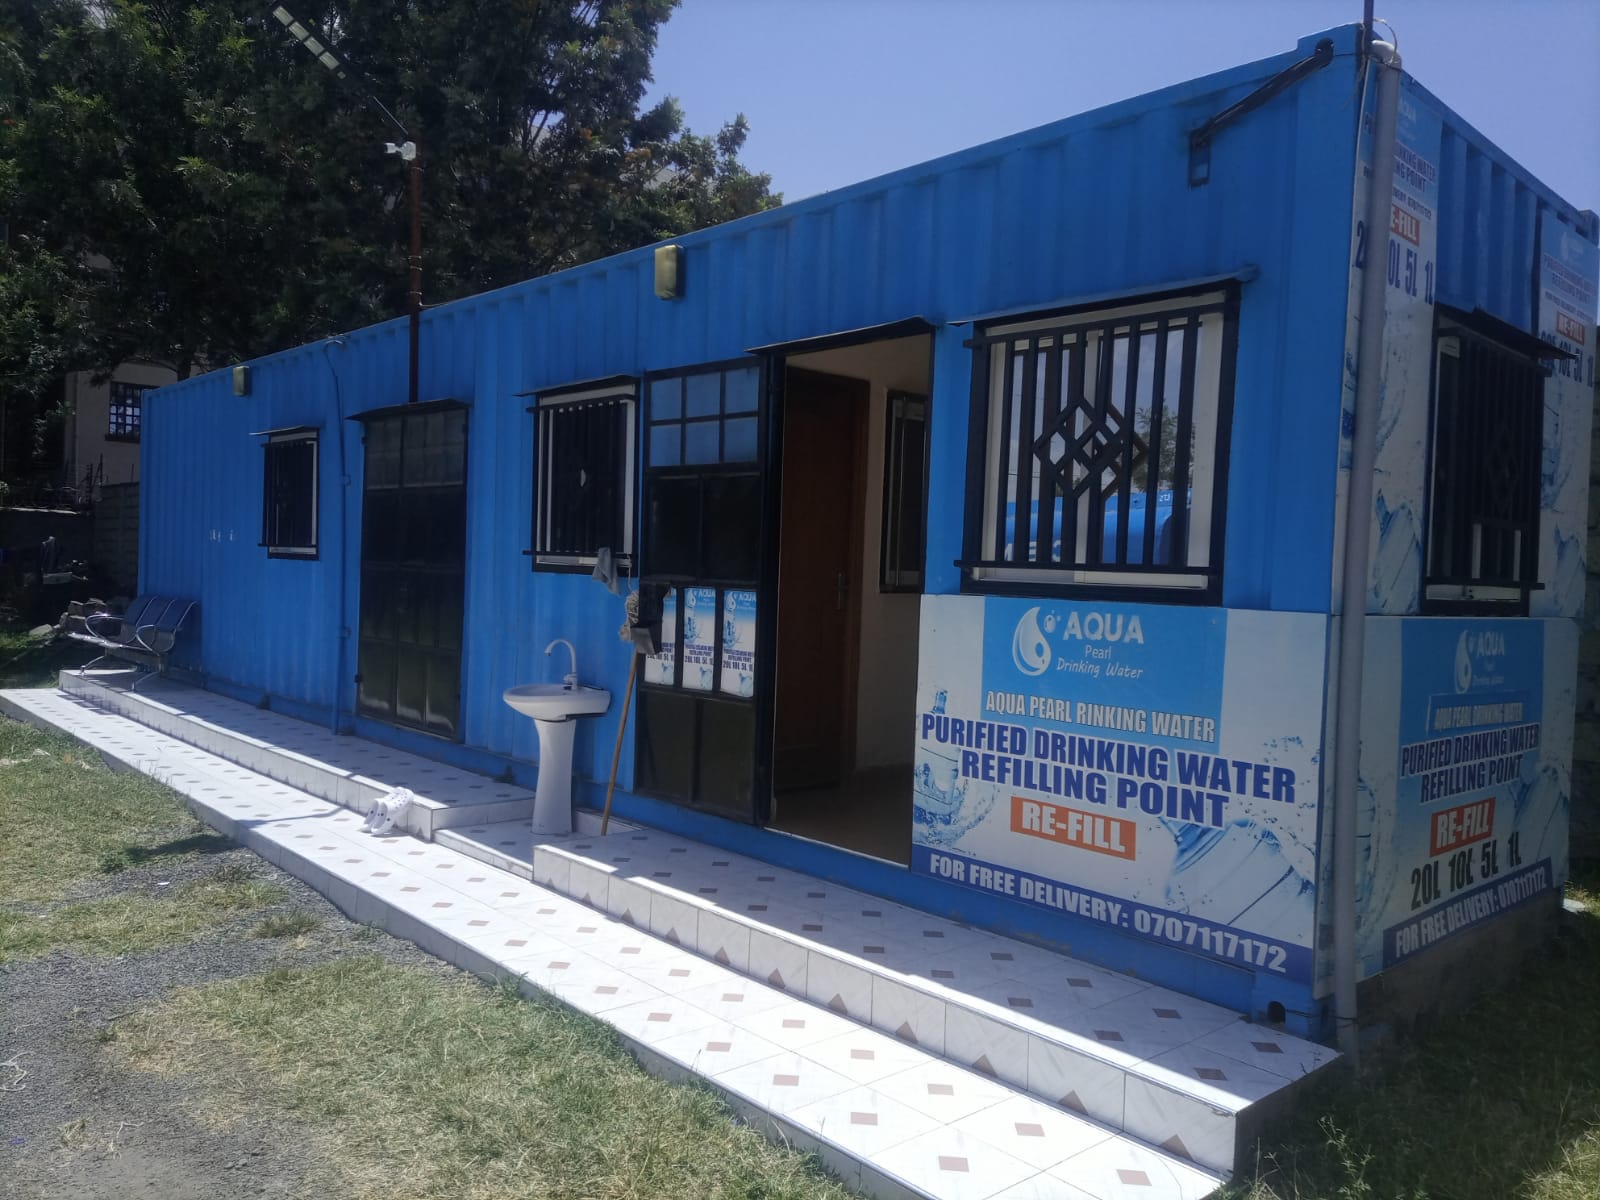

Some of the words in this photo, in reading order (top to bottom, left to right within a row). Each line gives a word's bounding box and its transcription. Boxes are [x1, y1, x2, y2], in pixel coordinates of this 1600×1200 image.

[1392, 206, 1416, 241] E-FILL
[1062, 611, 1145, 645] AQUA
[1085, 644, 1112, 660] Pearl
[1477, 631, 1505, 657] AQUA
[1056, 658, 1101, 678] Drinking
[1105, 662, 1144, 680] Water
[986, 690, 1026, 716] AQUA
[1029, 695, 1073, 723] PEARL
[1076, 701, 1148, 734] RINKING
[1151, 711, 1216, 743] WATER
[922, 713, 1028, 756] PURIFIED
[1034, 729, 1169, 782] DRINKING
[1176, 752, 1297, 804] WATER
[1402, 738, 1452, 777] PURIFIED
[1454, 729, 1508, 764] DRINKING
[1508, 724, 1540, 753] WATER
[961, 750, 1108, 806] REFILLING
[1116, 777, 1230, 828] POINT
[1421, 761, 1485, 804] REFILLING
[1488, 754, 1523, 785] POINT
[1021, 800, 1127, 853] RE-FILL
[1436, 802, 1489, 849] RE-FILL
[1411, 860, 1441, 912] 20L
[1448, 848, 1474, 892] 10L
[1481, 839, 1499, 879] 5L
[1508, 831, 1522, 868] 1L
[929, 853, 966, 882] FOR
[969, 863, 1016, 896] FREE
[1019, 877, 1129, 929] DELIVERY:
[1133, 909, 1288, 974] 0707117172
[1396, 923, 1420, 958] FOR
[1421, 910, 1447, 946] FREE
[1447, 888, 1500, 932] DELIVERY:
